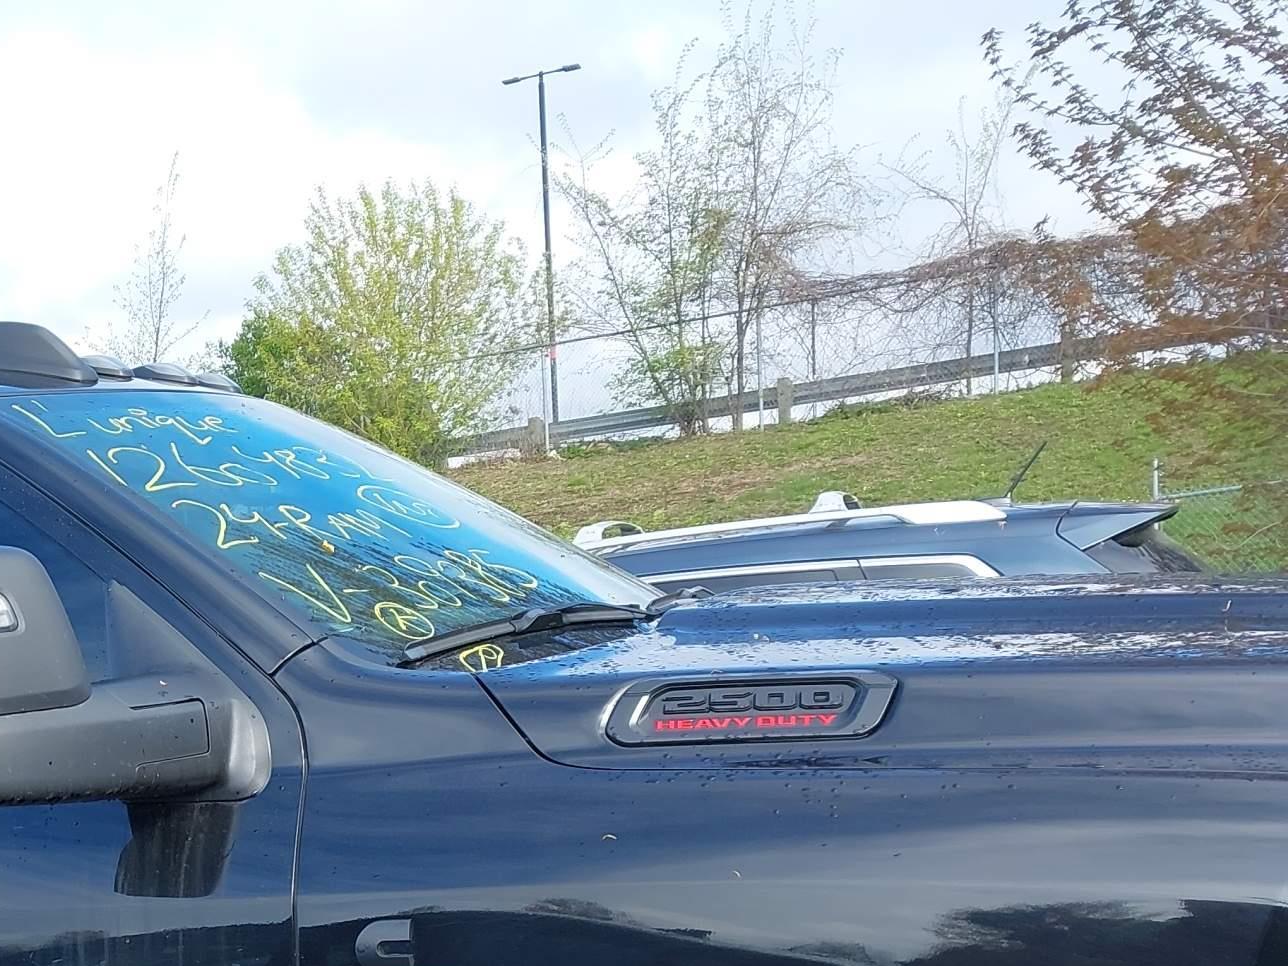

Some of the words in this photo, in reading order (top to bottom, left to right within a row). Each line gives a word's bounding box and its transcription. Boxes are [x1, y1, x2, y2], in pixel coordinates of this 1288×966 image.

[661, 689, 843, 715] 2500
[654, 717, 752, 732] HEAVY
[754, 714, 837, 729] DUTY
